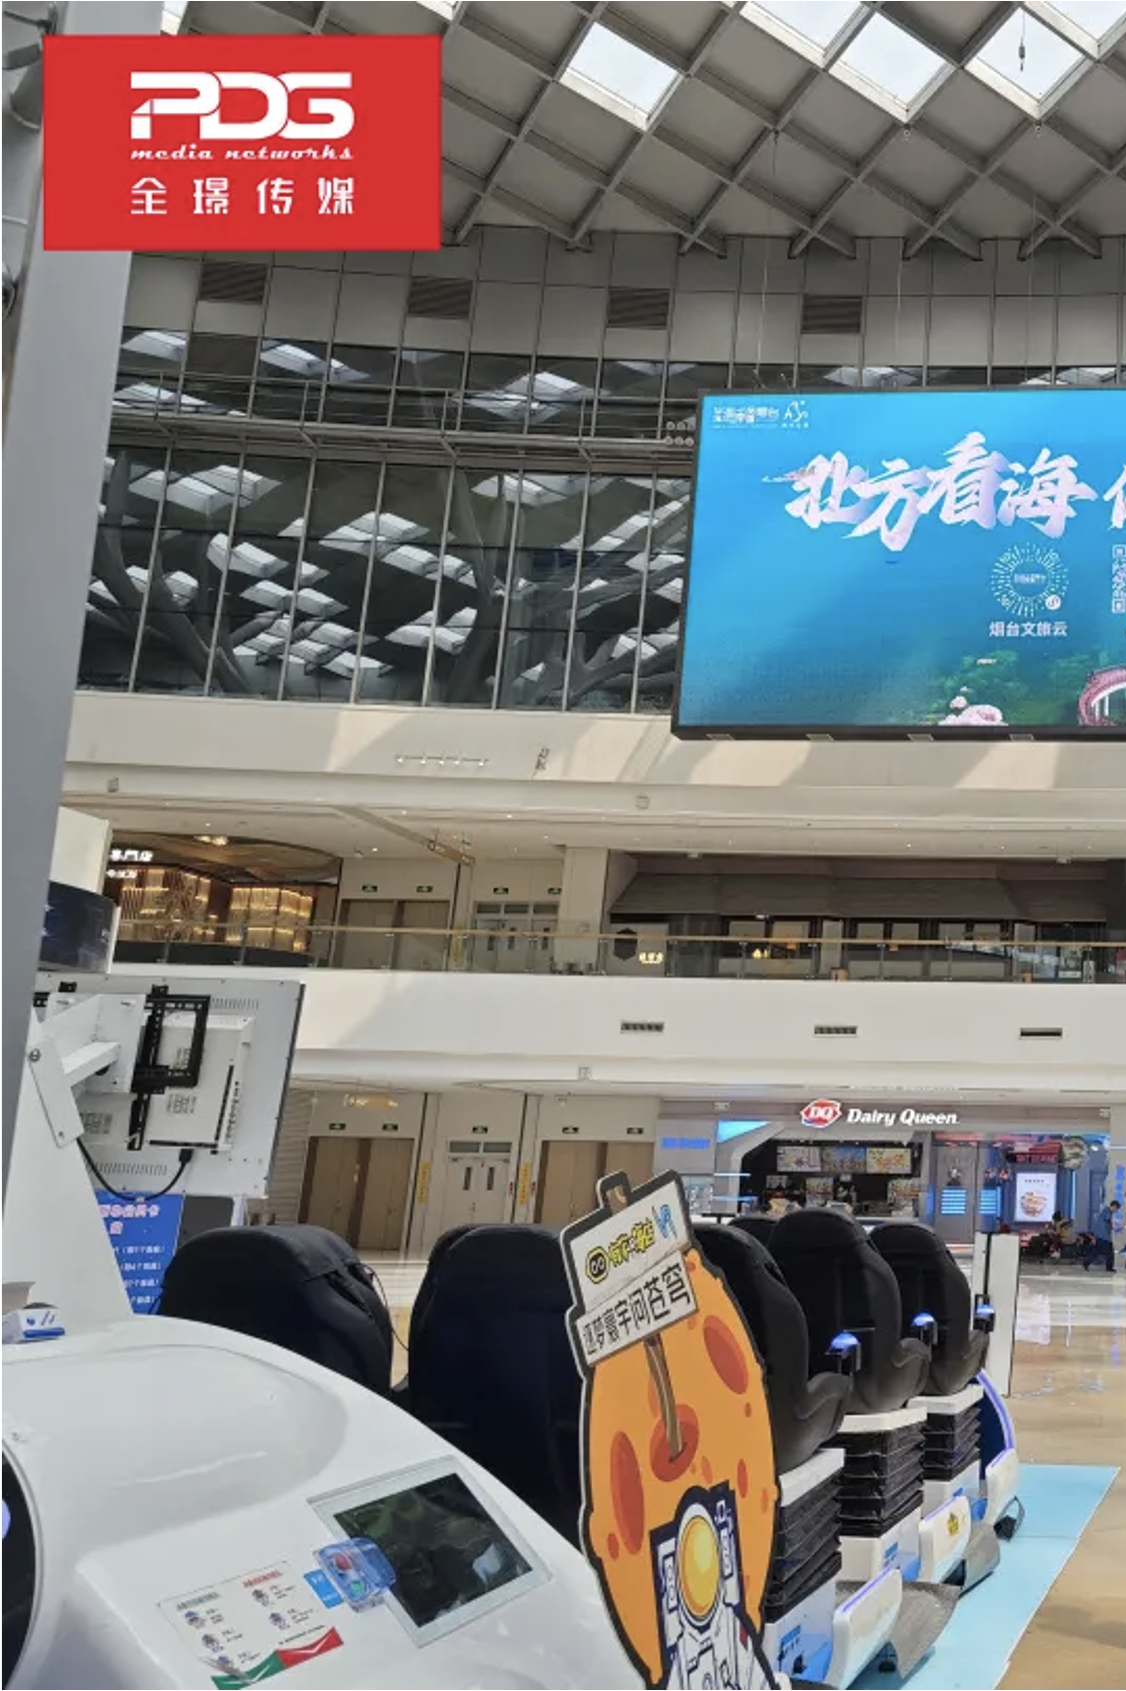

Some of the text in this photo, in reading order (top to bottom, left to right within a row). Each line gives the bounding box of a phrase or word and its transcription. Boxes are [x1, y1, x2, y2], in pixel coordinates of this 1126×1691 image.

[783, 431, 1097, 551] 北方看海
[847, 1108, 956, 1126] Dairy Queen
